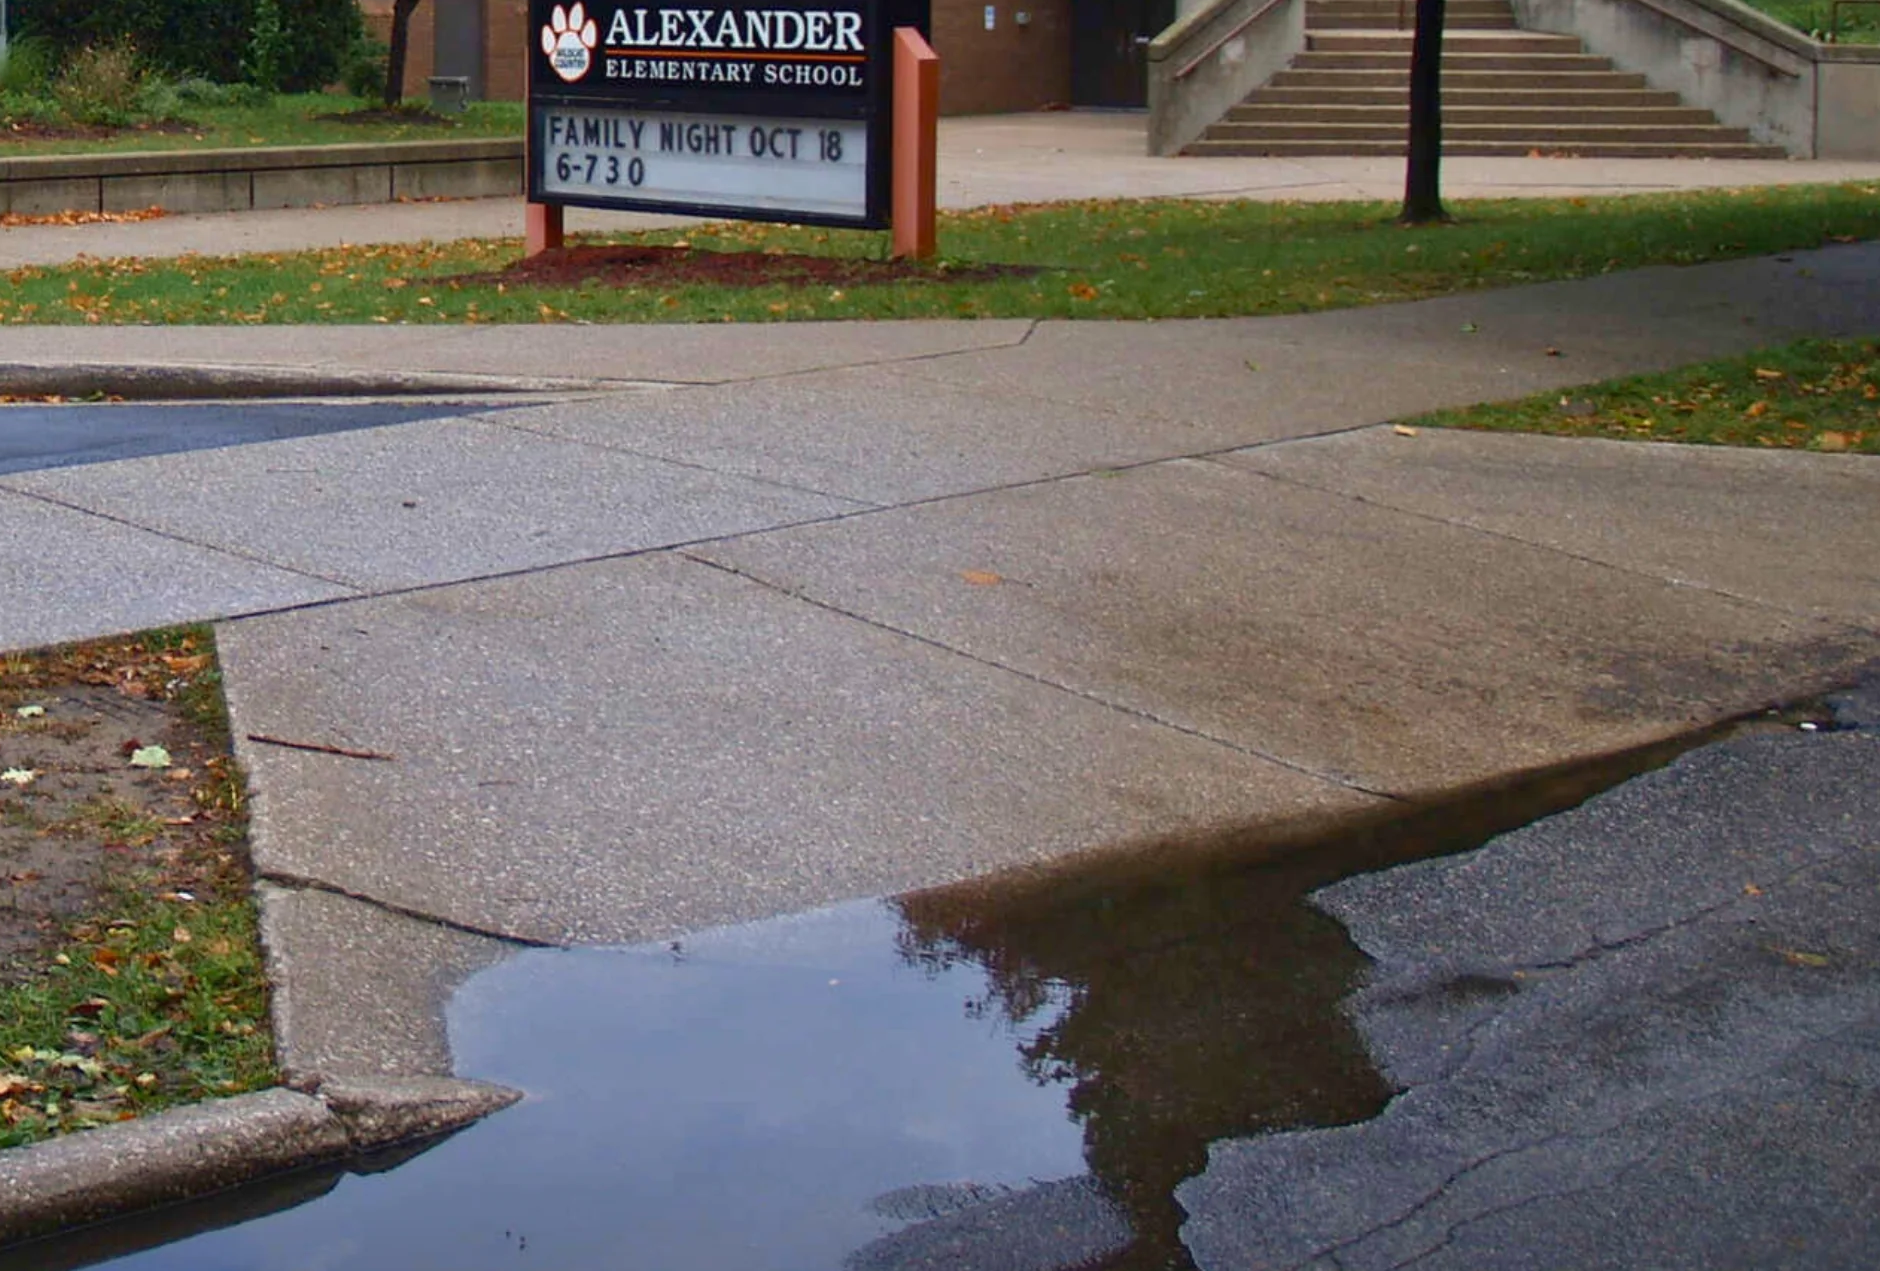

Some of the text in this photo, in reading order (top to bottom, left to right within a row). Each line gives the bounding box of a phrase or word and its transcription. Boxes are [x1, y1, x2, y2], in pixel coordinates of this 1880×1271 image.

[605, 9, 865, 50] ALEXANDER
[605, 59, 863, 86] ELEMENTARY SCHOOL
[550, 116, 842, 162] FAMILY NIGHT OCT 18
